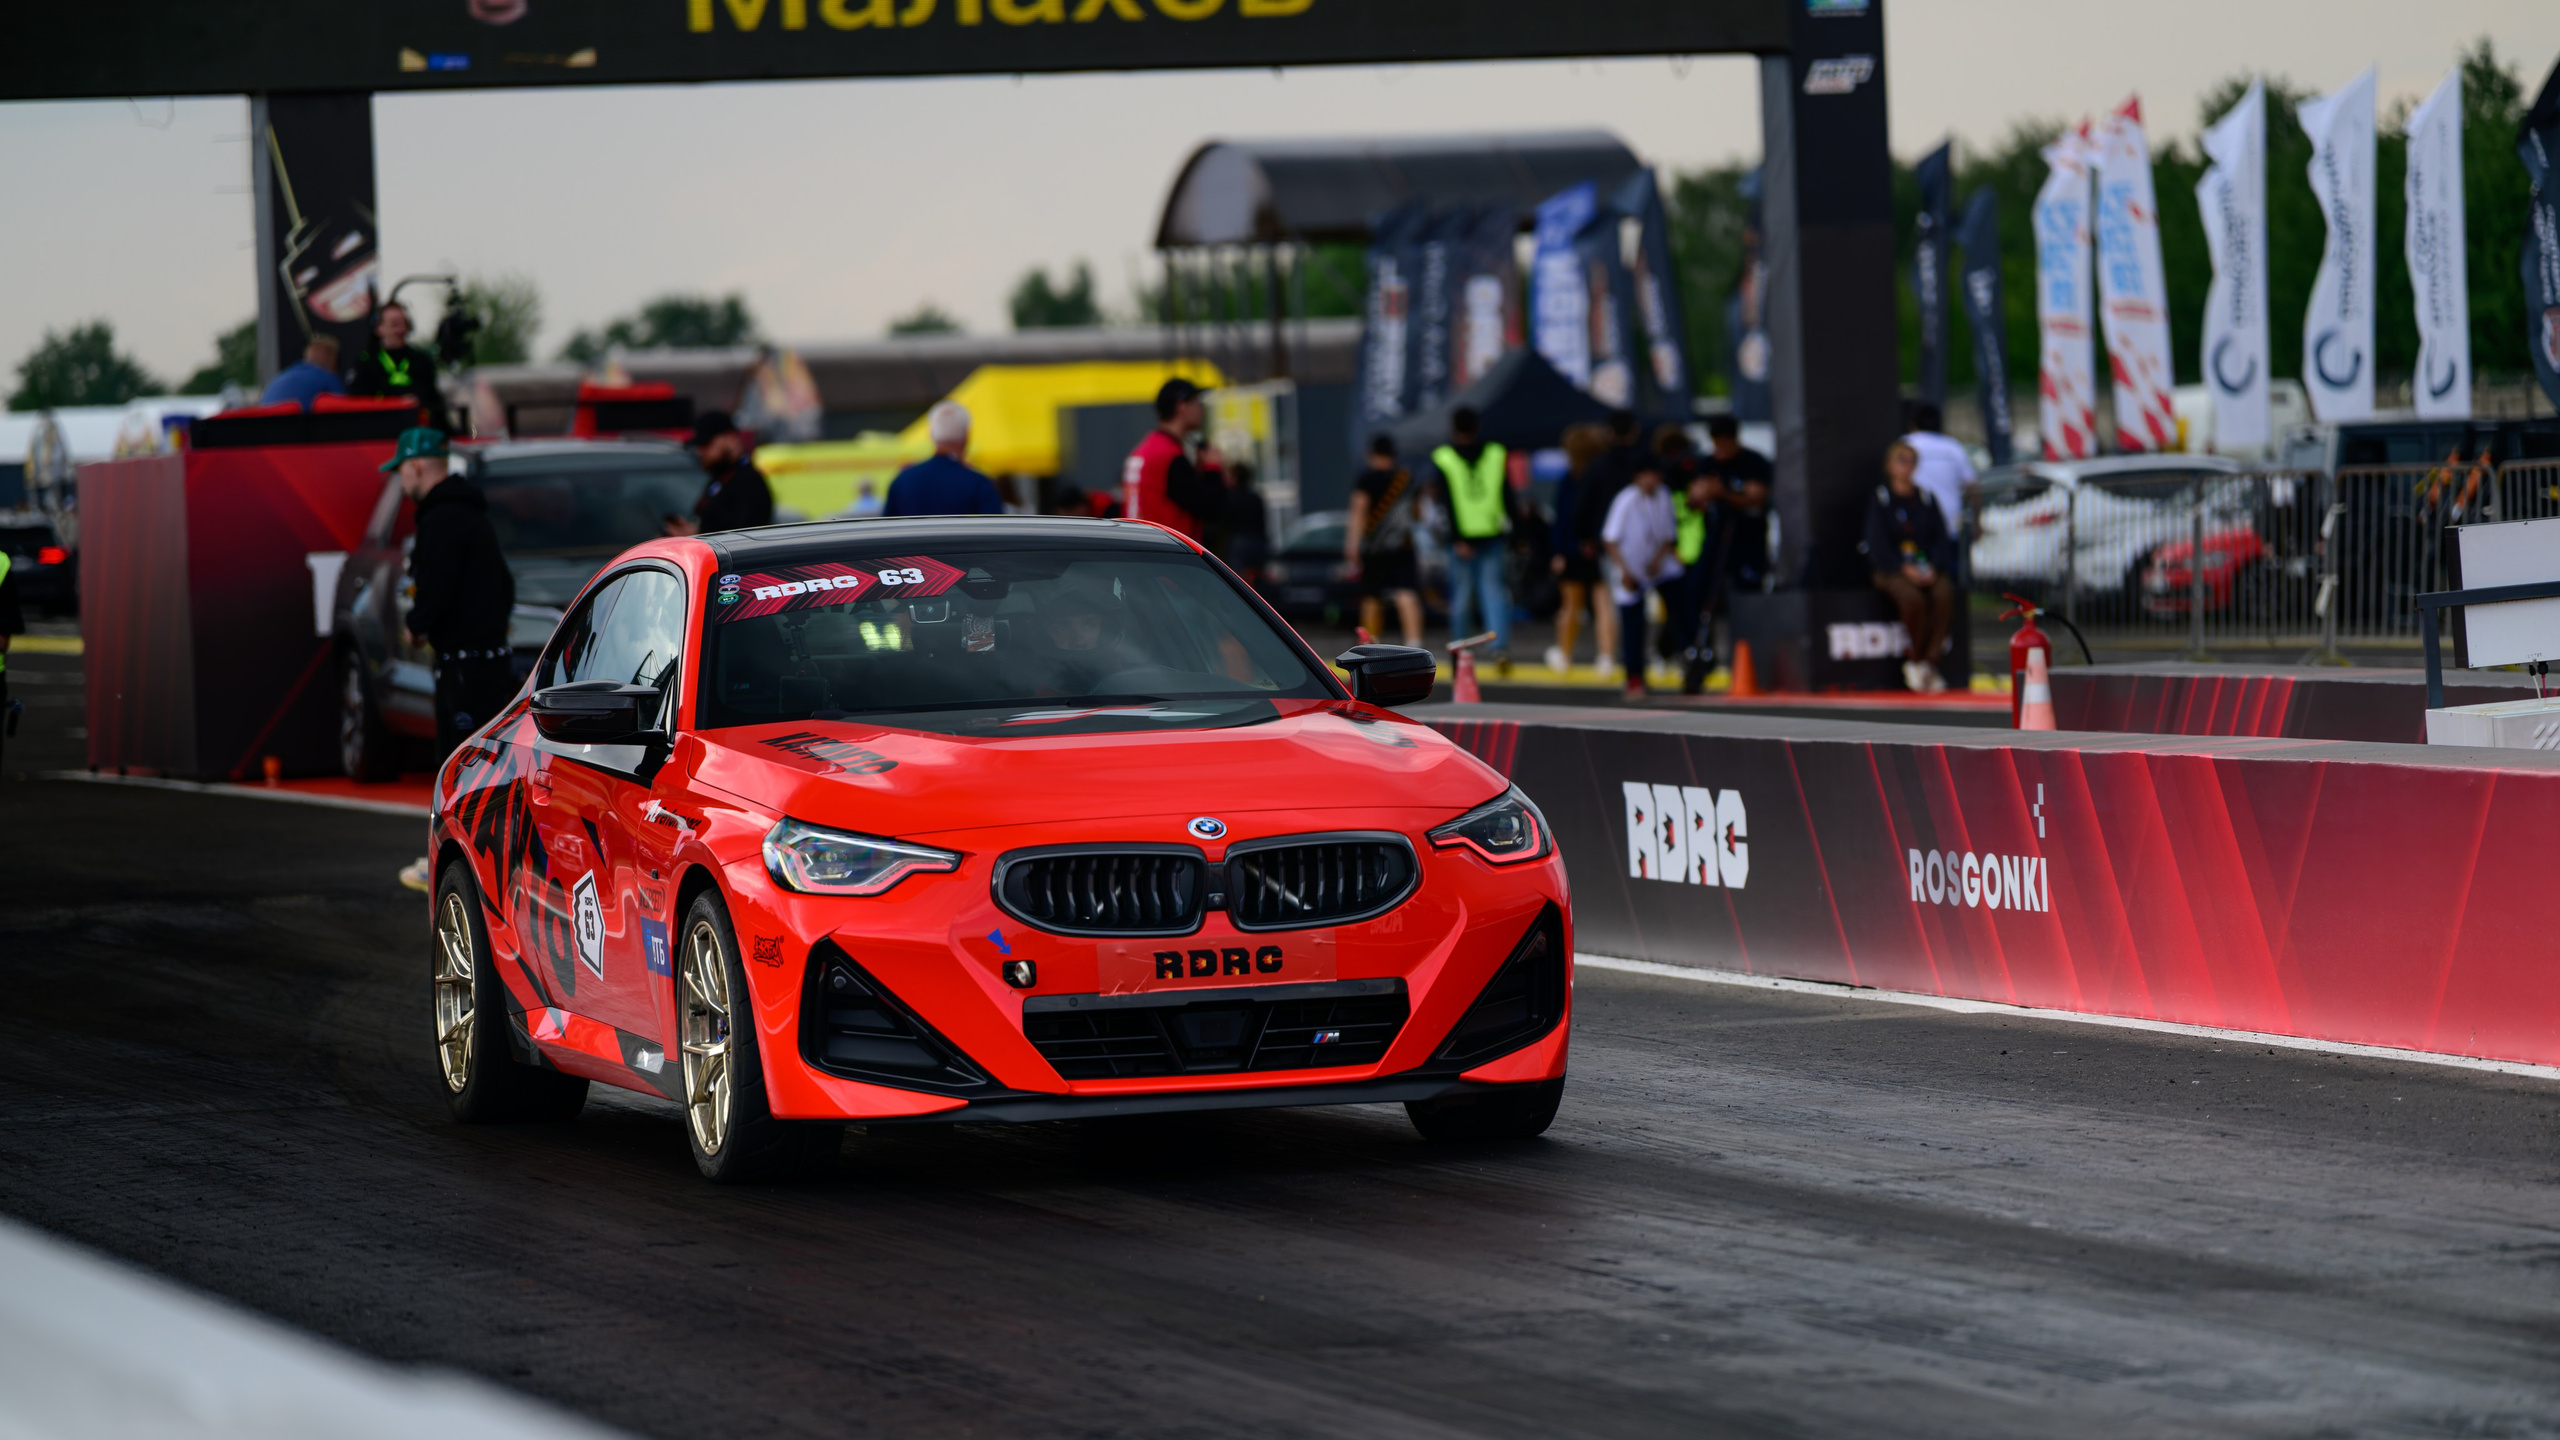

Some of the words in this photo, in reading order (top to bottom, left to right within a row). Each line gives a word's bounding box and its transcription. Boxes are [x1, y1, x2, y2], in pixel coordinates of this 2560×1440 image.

[752, 575, 859, 600] RDRC
[878, 568, 925, 586] 63
[1828, 621, 1914, 661] RDR
[1622, 781, 1749, 889] RDRC
[1908, 848, 2049, 912] ROSGONKI
[584, 909, 596, 941] 63
[1153, 946, 1283, 979] RDRC
